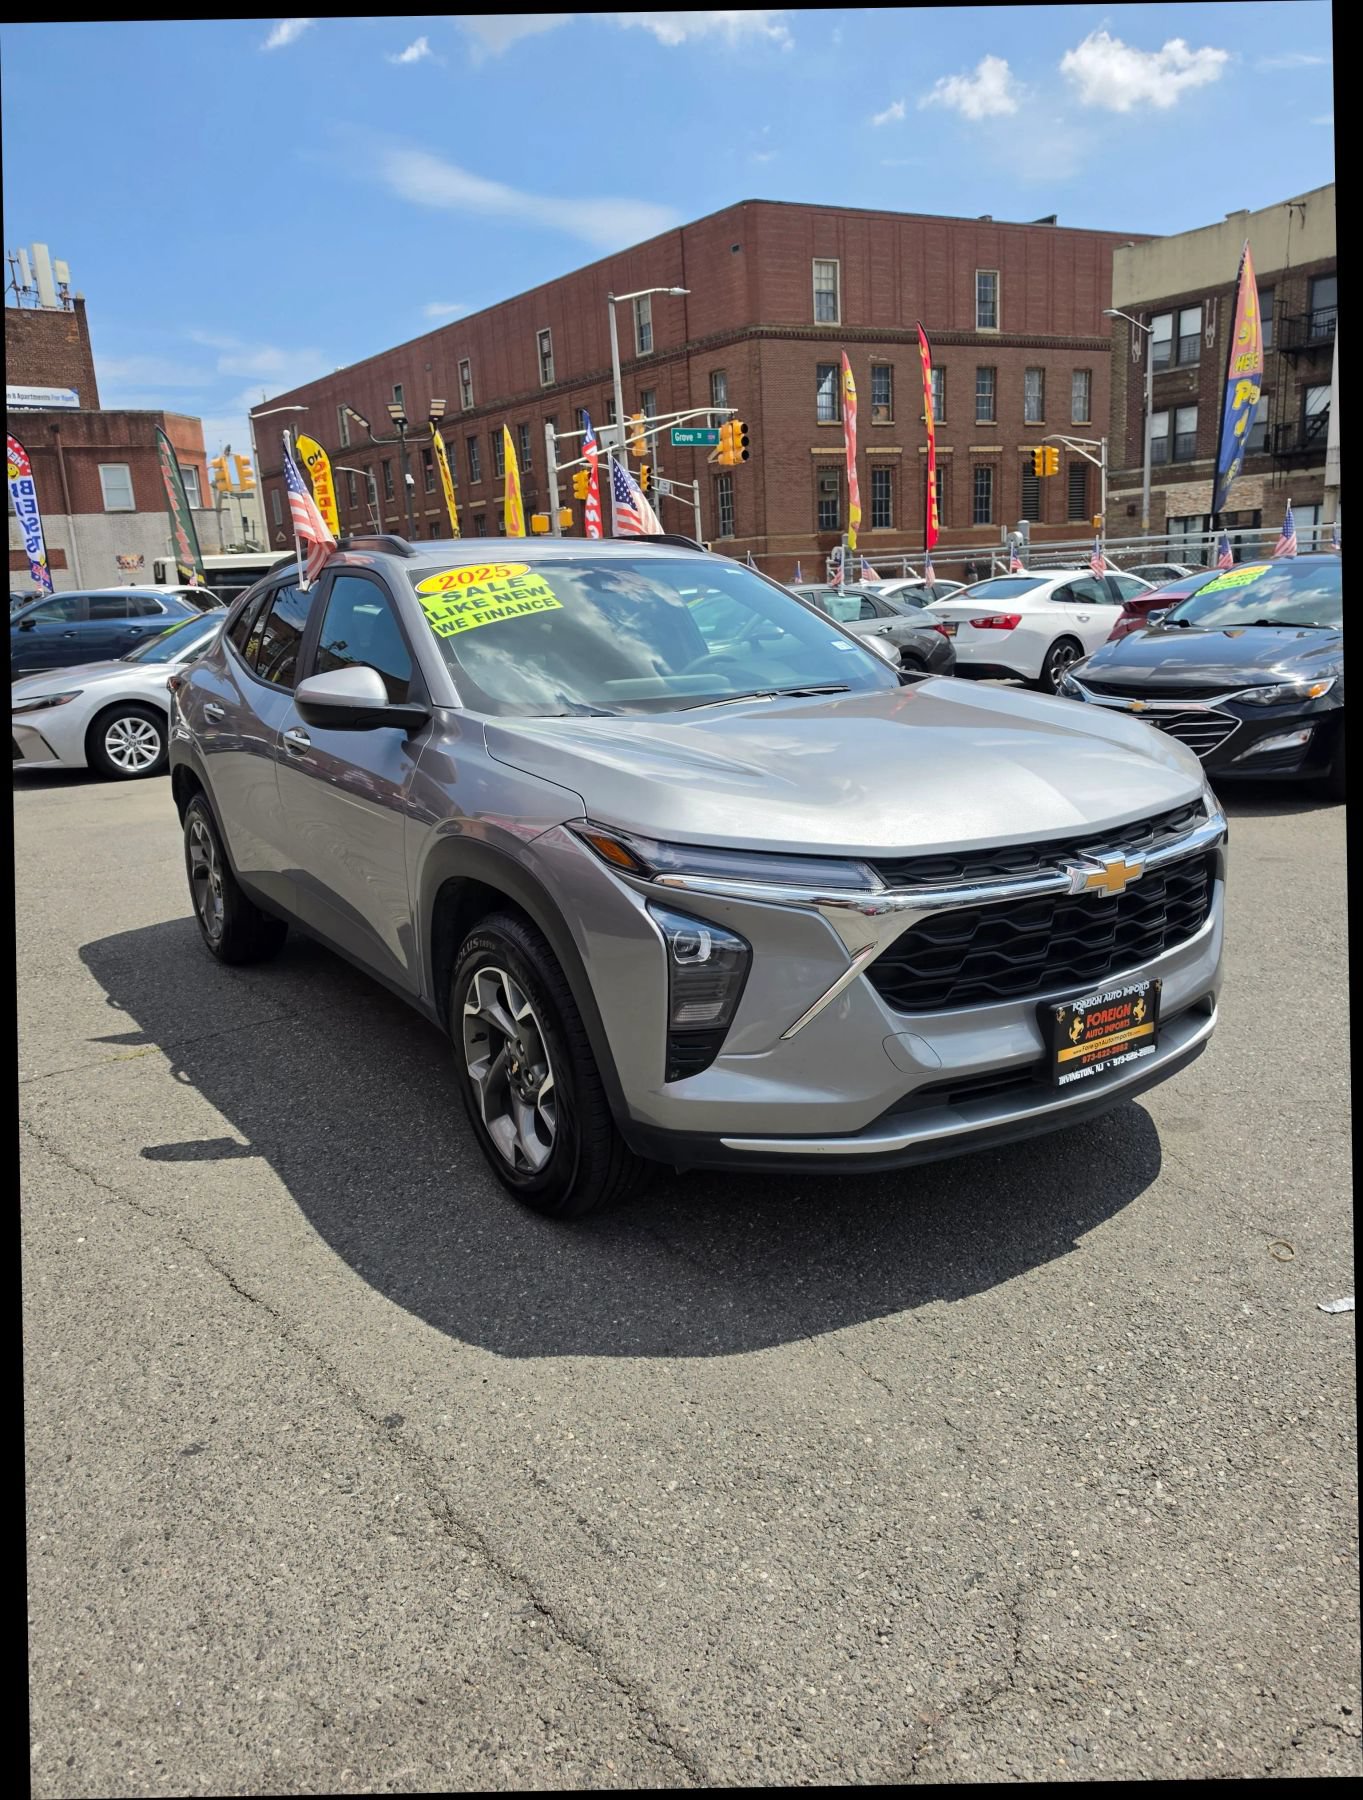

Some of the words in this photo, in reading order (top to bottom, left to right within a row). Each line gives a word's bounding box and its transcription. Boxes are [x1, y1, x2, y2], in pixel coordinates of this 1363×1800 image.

[674, 431, 694, 442] Grove
[438, 564, 512, 591] 2025
[441, 576, 527, 604] SALE
[430, 597, 491, 621] LIKE
[491, 586, 547, 604] NEW
[436, 617, 470, 635] WE
[471, 597, 557, 623] FINANCE
[1072, 994, 1103, 1012] FOREIGN
[1103, 989, 1122, 1003] AUTO
[1123, 980, 1150, 997] IMPORTS
[1086, 1002, 1132, 1028] FOREIGN
[1085, 1027, 1104, 1040] AUTO
[1104, 1019, 1130, 1034] IMPORTS
[1095, 1062, 1105, 1072] NJ
